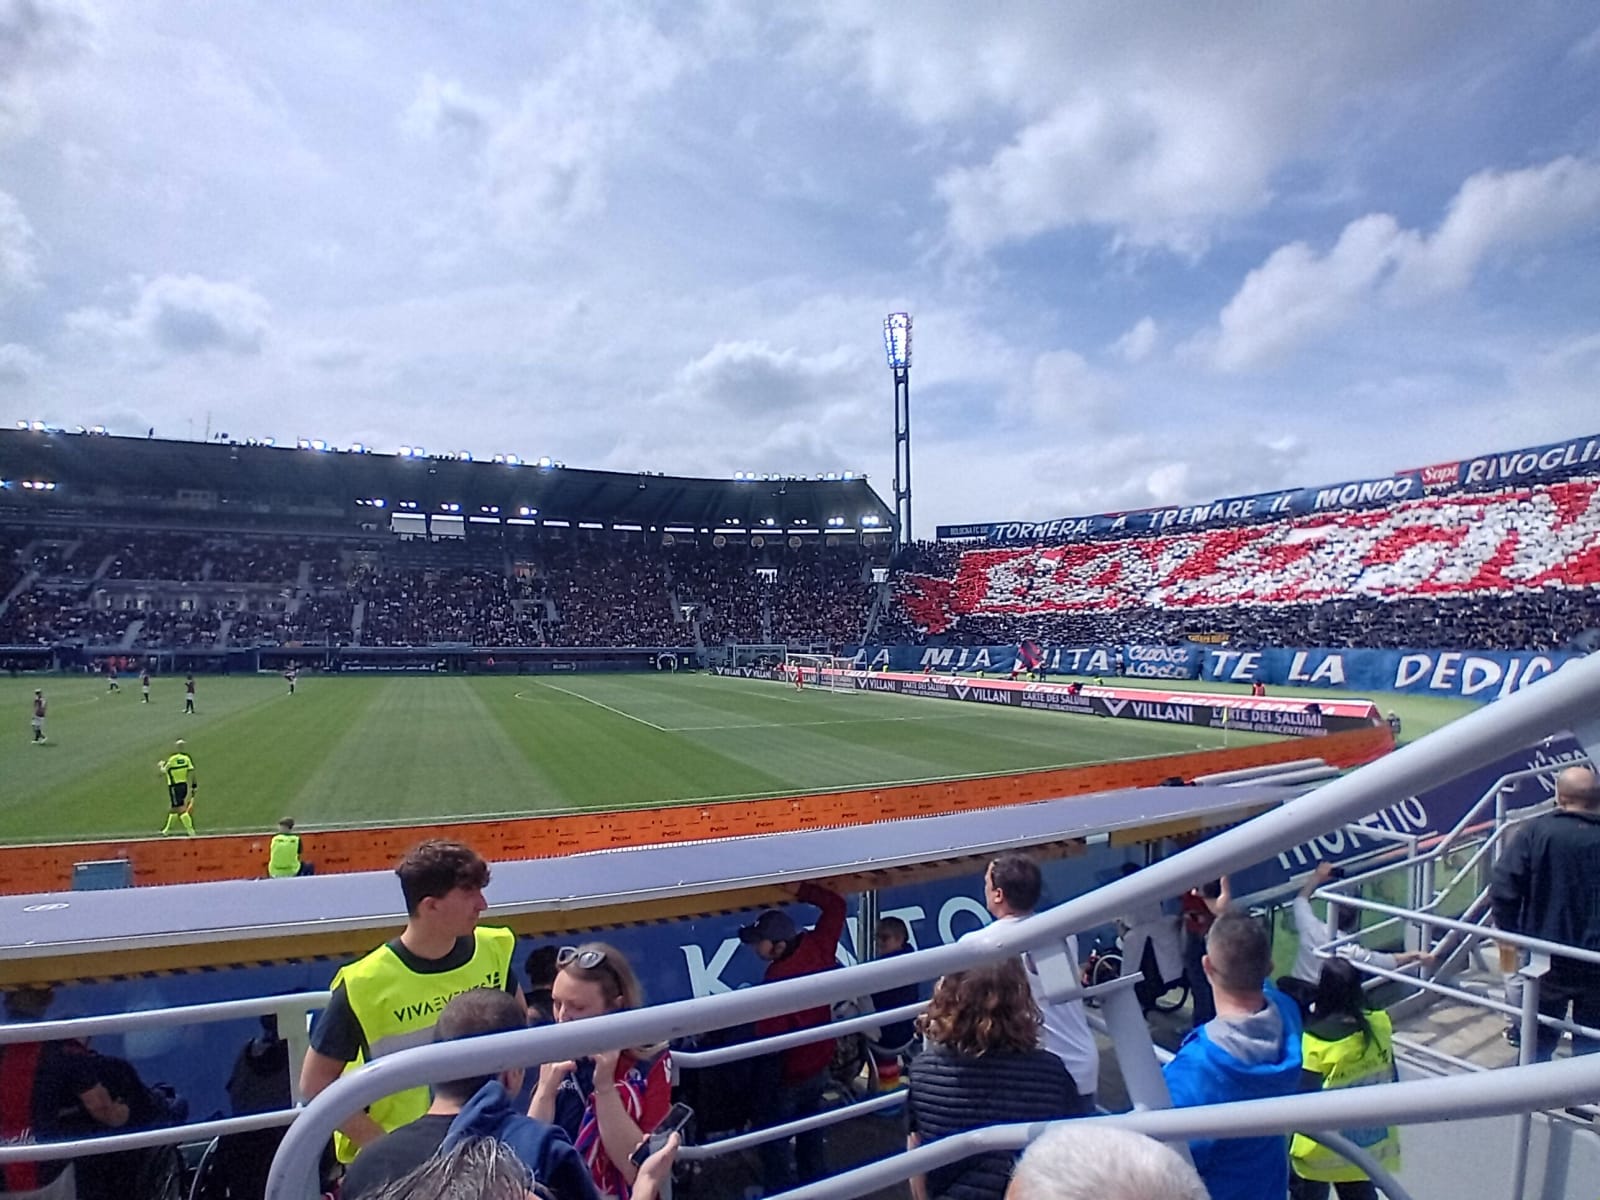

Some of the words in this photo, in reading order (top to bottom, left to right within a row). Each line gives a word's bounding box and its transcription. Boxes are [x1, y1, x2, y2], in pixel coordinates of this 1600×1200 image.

[1111, 513, 1127, 532] A
[1149, 499, 1256, 529] TREMARE
[1270, 495, 1292, 513] IL
[1314, 478, 1413, 509] MONDO
[1464, 440, 1600, 485] RIVOGLI
[920, 647, 992, 667] MIA
[1041, 648, 1109, 671] ITA
[1211, 650, 1262, 679] TE
[1288, 650, 1345, 685] LA
[1394, 652, 1580, 699] DEDIC
[869, 678, 896, 691] VILLANI
[972, 687, 1011, 704] VILLANI
[1131, 701, 1193, 722] VILLANI
[1251, 710, 1271, 723] DEI
[1275, 711, 1321, 727] SALUMI
[393, 982, 486, 1022] VIVAEV
